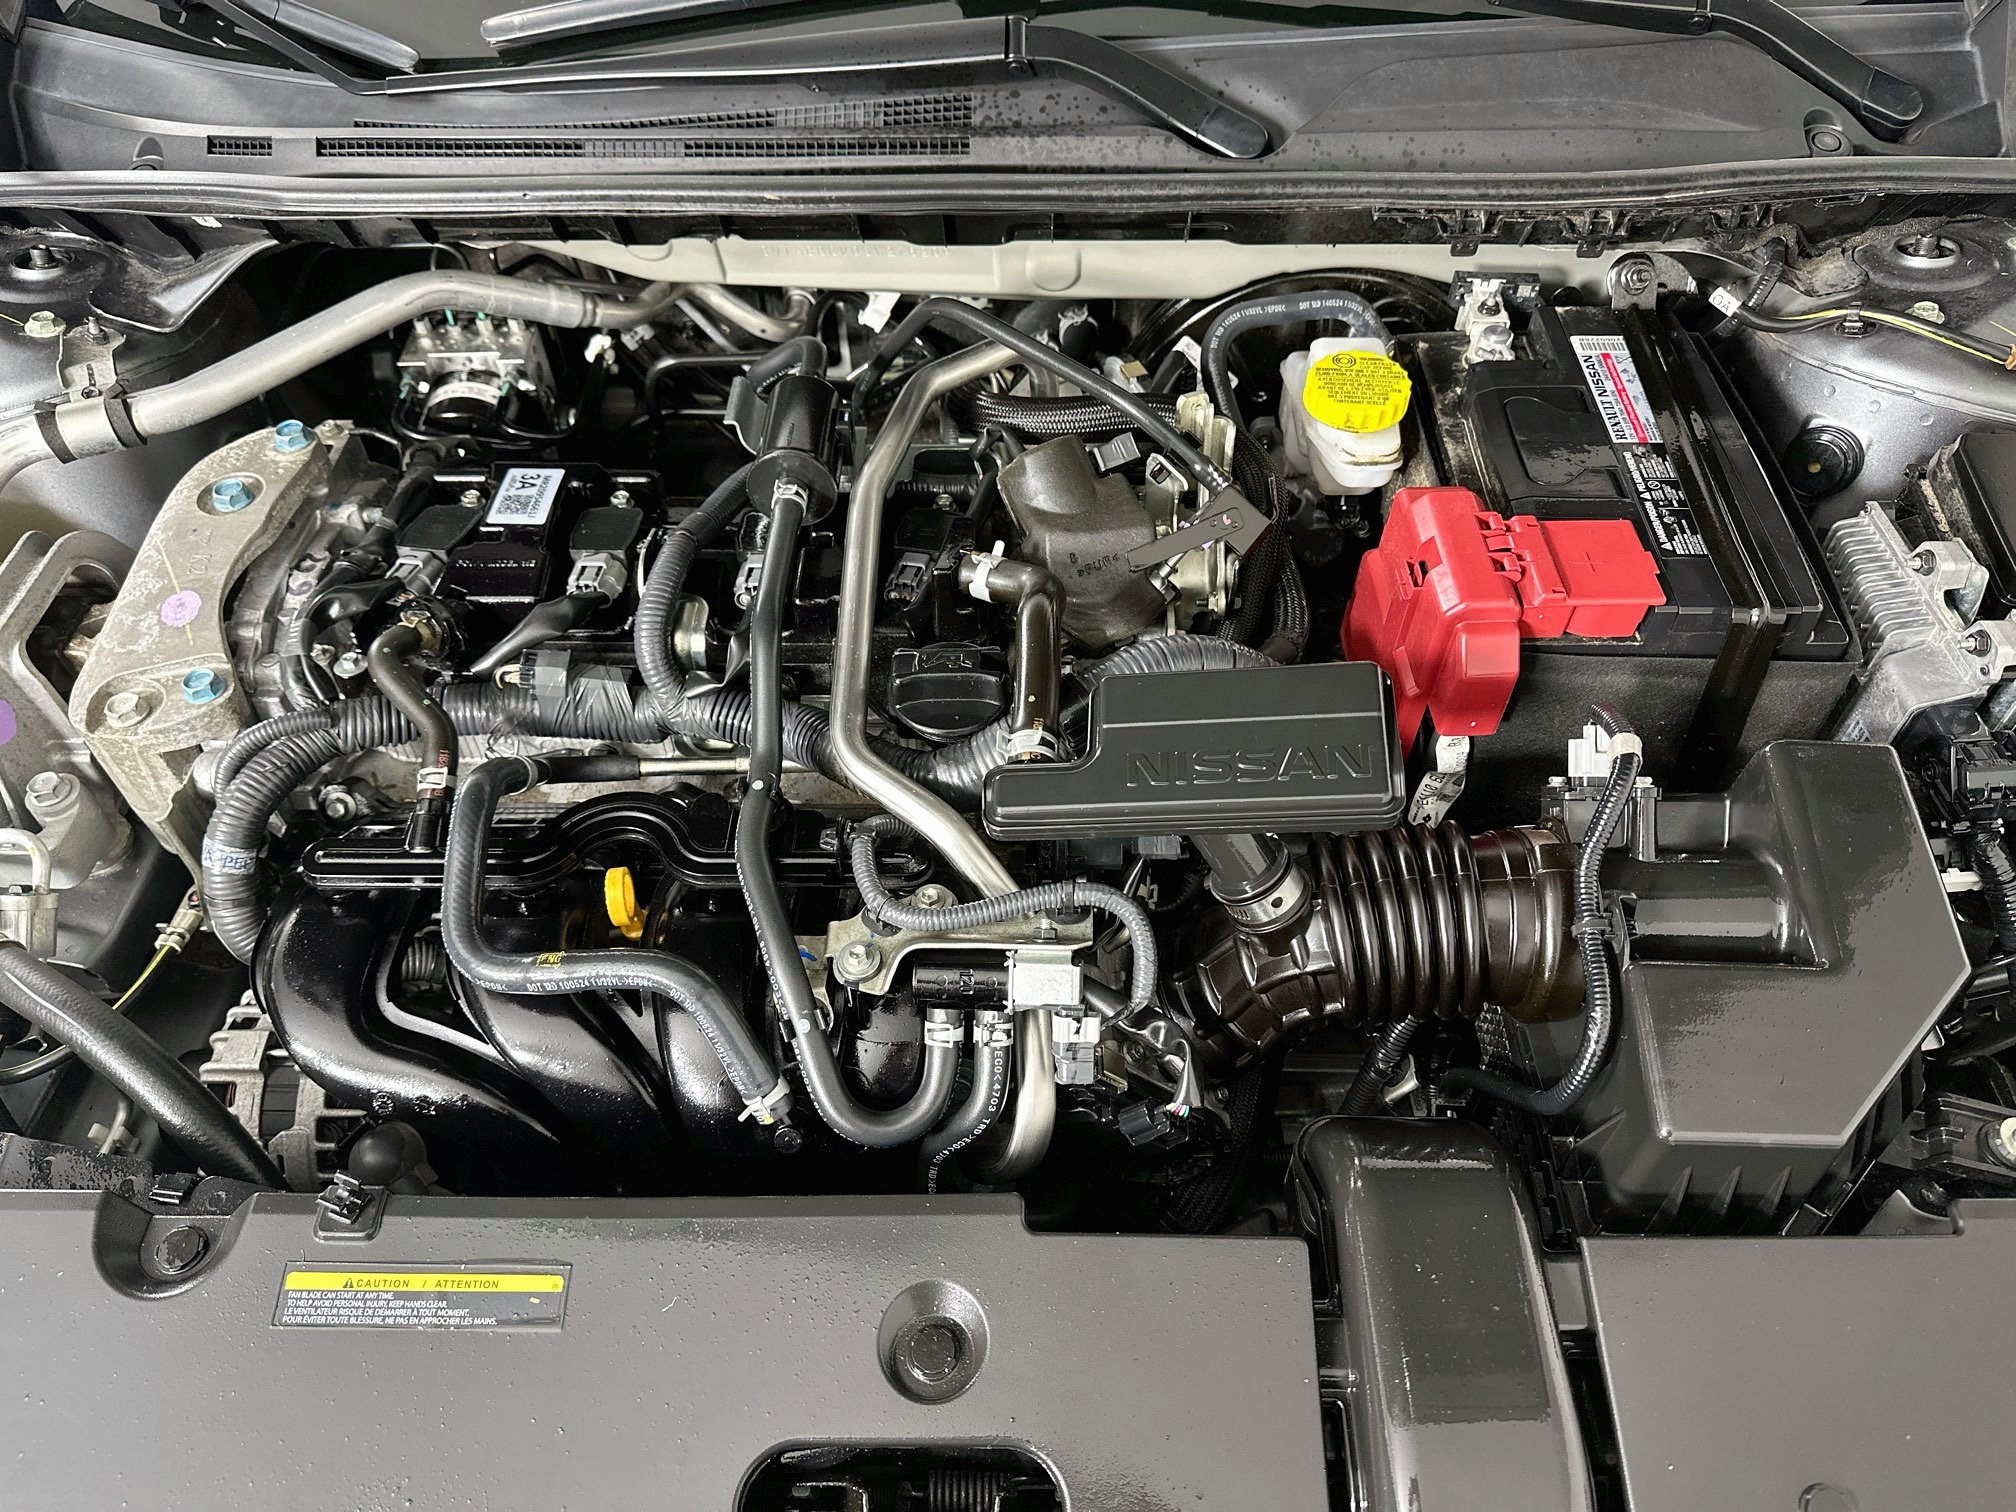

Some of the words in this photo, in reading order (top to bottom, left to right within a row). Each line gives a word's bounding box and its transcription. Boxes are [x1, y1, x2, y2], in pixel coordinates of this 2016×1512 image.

[1581, 355, 1609, 398] NISSAN
[1601, 400, 1628, 440] RENAULT
[516, 474, 540, 490] 3A
[1126, 745, 1372, 786] NISSAN
[928, 1166, 938, 1195] TRD>EC
[356, 1279, 410, 1288] CAUTION
[422, 1280, 427, 1288] /
[434, 1280, 500, 1288] ATTENTION
[288, 1291, 301, 1299] FAN
[301, 1291, 322, 1299] BLADE
[322, 1291, 335, 1299] CAN
[332, 1299, 365, 1307] PERSONAL
[365, 1300, 388, 1308] INJURY,
[374, 1307, 411, 1316] DÉMARRER
[302, 1314, 326, 1324] ÉVITER
[349, 1316, 384, 1325] BLESSURE,
[419, 1317, 460, 1325] APPROCHER
